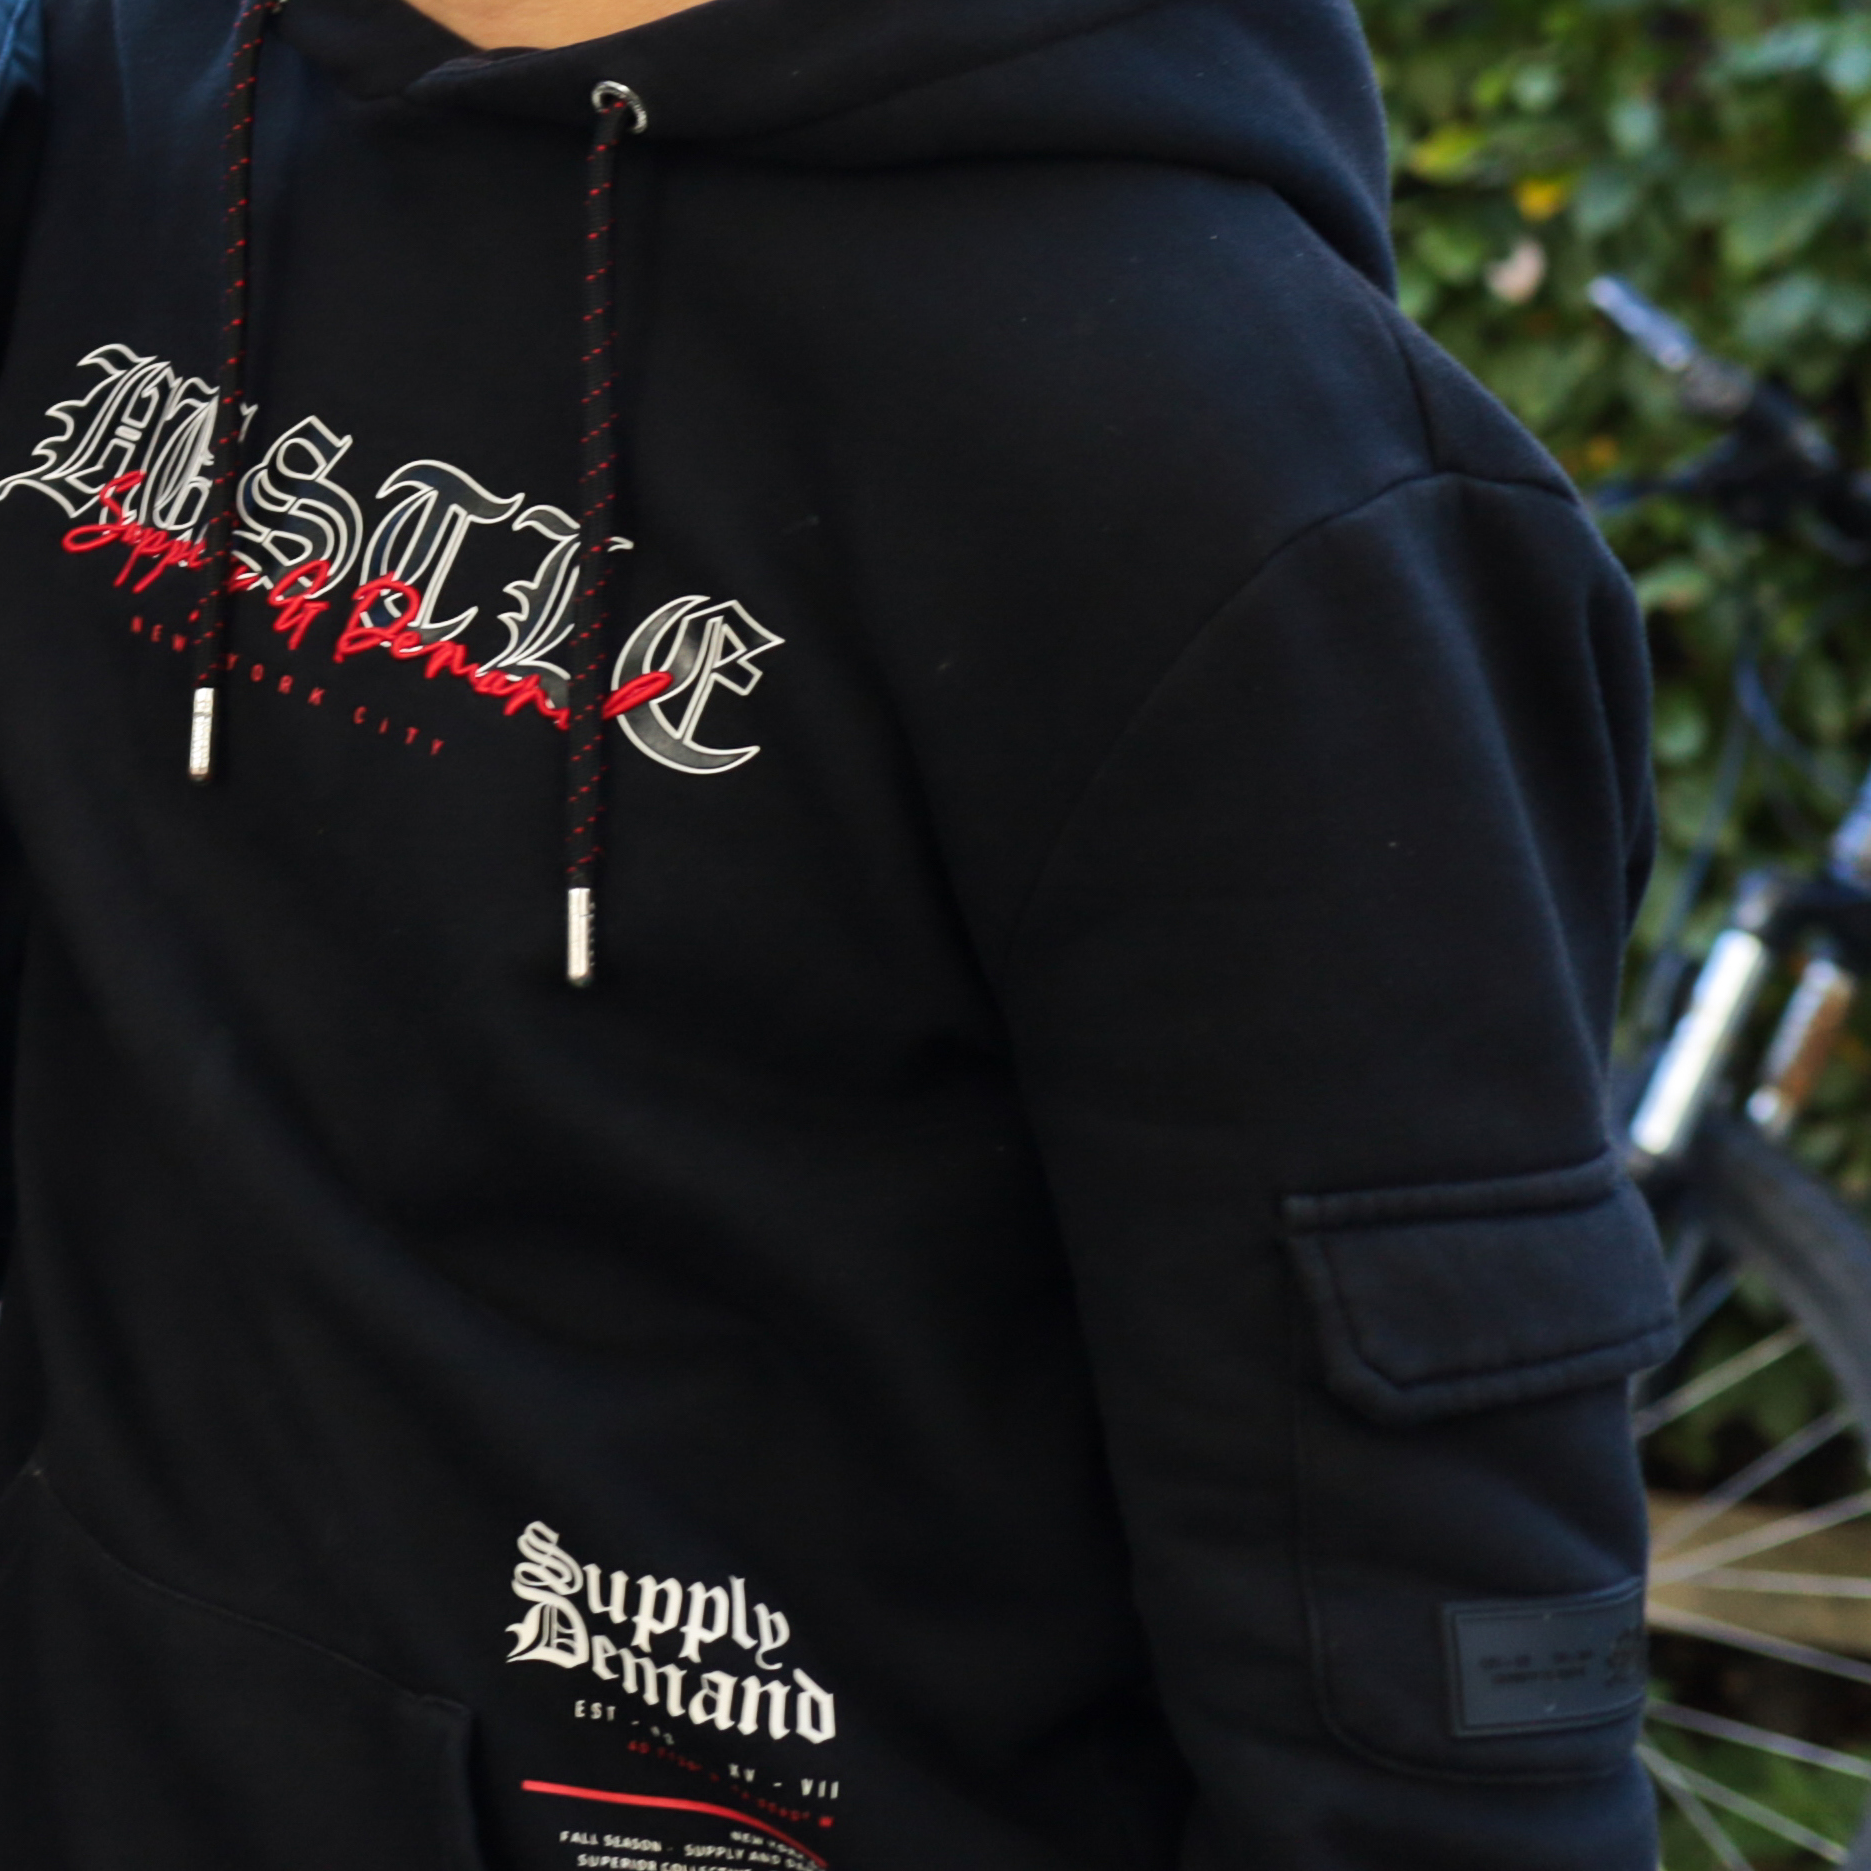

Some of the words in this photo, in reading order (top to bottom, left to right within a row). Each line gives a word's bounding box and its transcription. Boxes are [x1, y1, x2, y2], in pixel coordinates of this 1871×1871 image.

[130, 615, 187, 652] NEW
[226, 653, 328, 707] YORK
[353, 706, 445, 756] CITY
[511, 1520, 790, 1670] Supply
[505, 1599, 836, 1744] Demand
[574, 1700, 616, 1722] EST
[800, 1778, 839, 1800] VII
[559, 1830, 599, 1846] FALL
[603, 1834, 662, 1853] SEASON
[683, 1843, 745, 1861] SUPPLY
